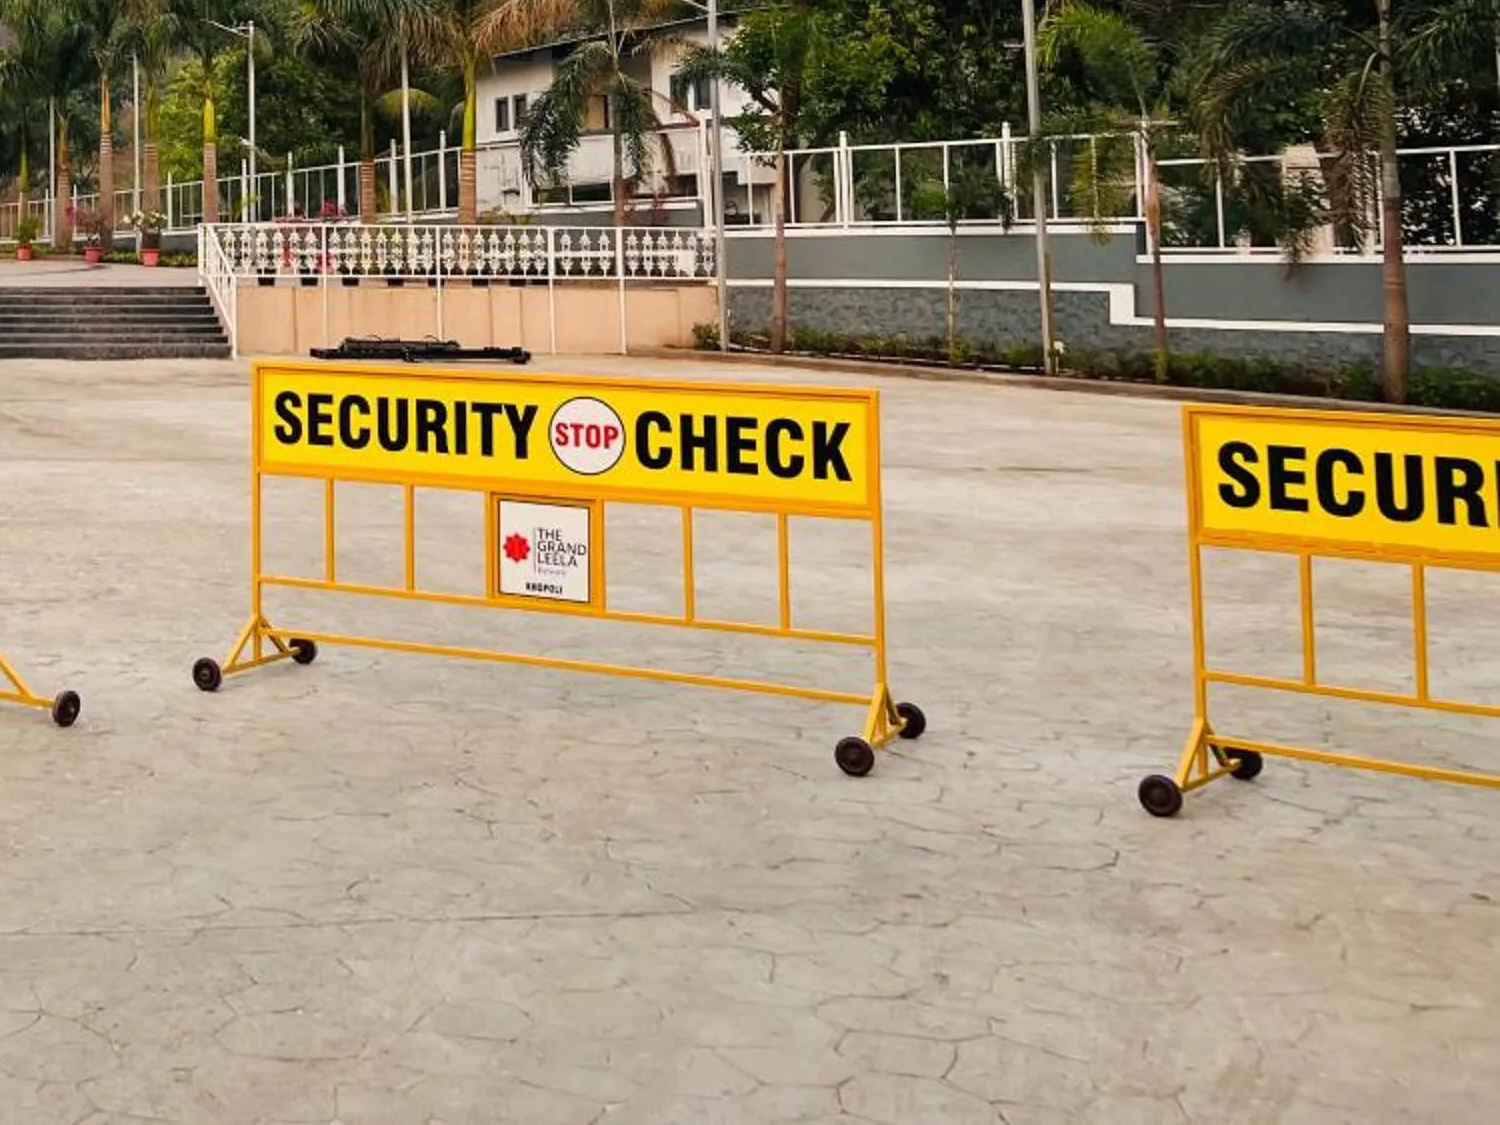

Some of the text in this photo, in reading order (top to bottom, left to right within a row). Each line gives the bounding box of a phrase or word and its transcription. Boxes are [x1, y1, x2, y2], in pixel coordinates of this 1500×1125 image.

[274, 391, 852, 481] SECURITY STOP CHECK
[1218, 441, 1500, 528] SECUR
[537, 527, 563, 541] THE
[537, 540, 587, 556] GRAND
[537, 553, 578, 568] LEELA
